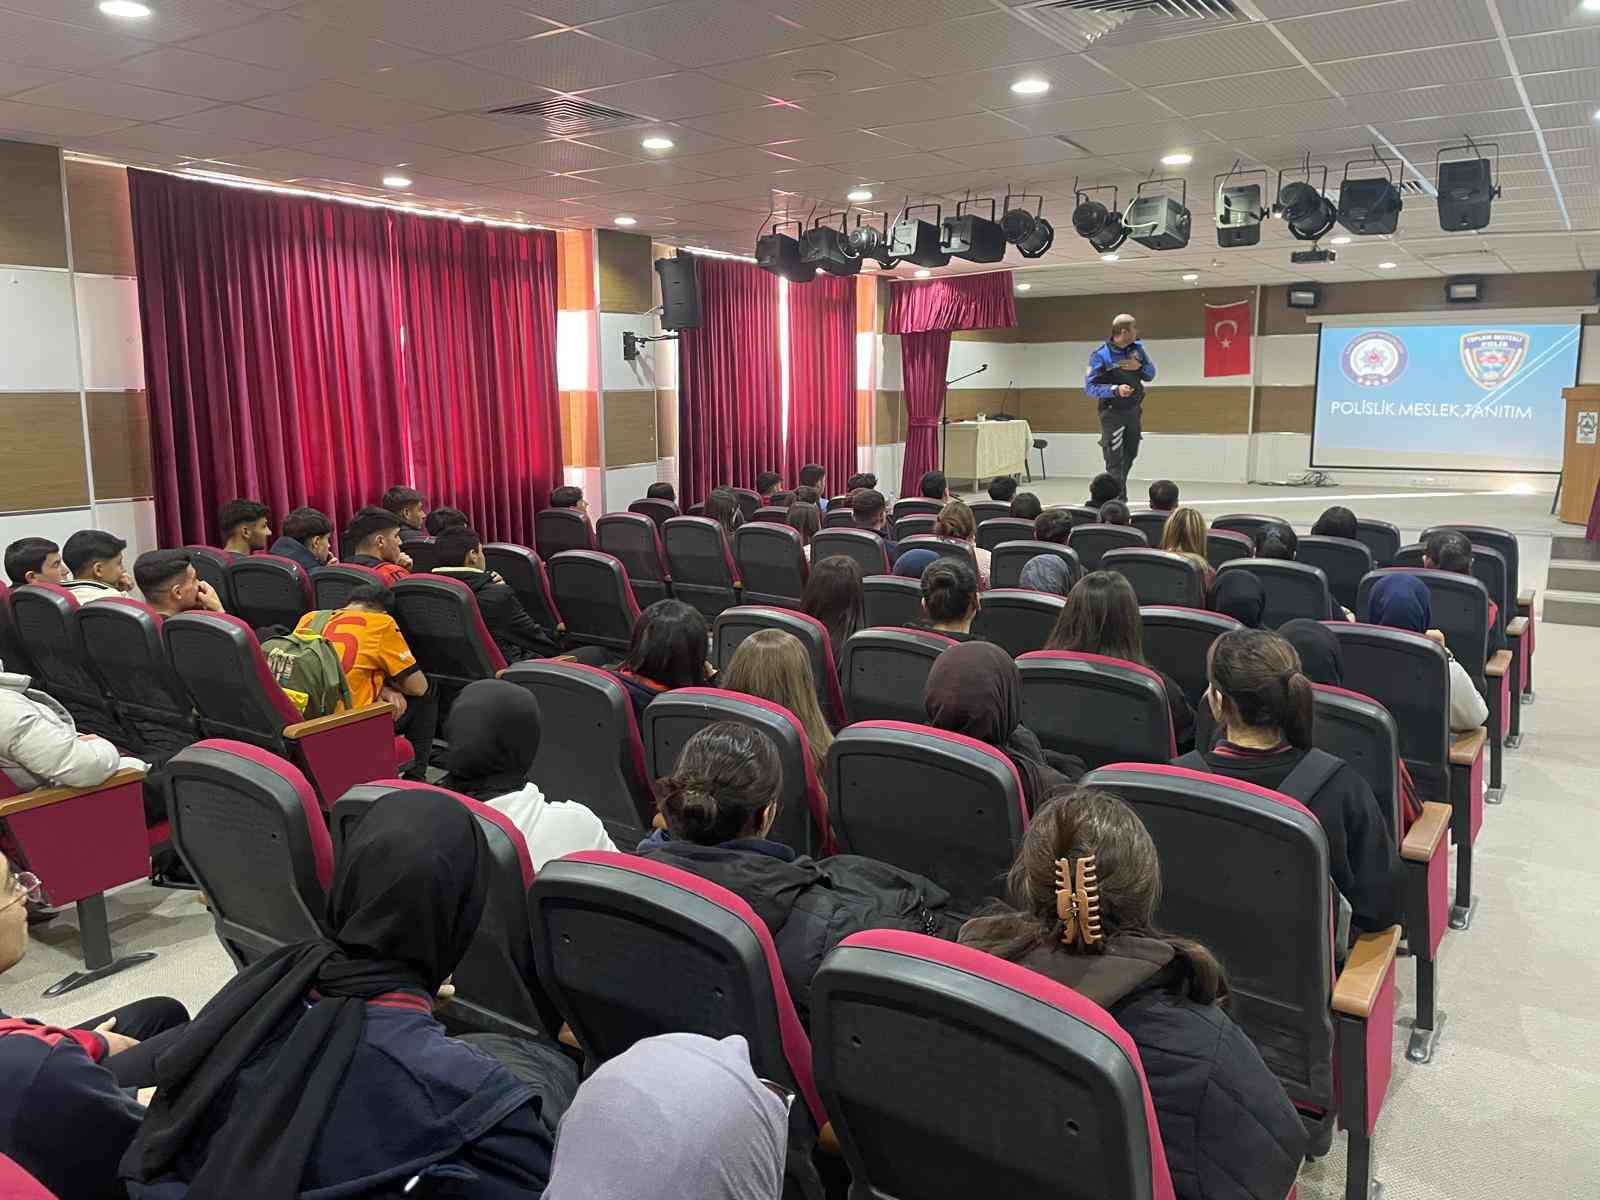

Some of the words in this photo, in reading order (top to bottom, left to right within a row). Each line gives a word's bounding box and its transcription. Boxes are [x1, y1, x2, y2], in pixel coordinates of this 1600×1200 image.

[1330, 399, 1395, 416] POLİSLİK
[1397, 401, 1462, 418] MESLEK
[1464, 403, 1534, 420] TANITIM
